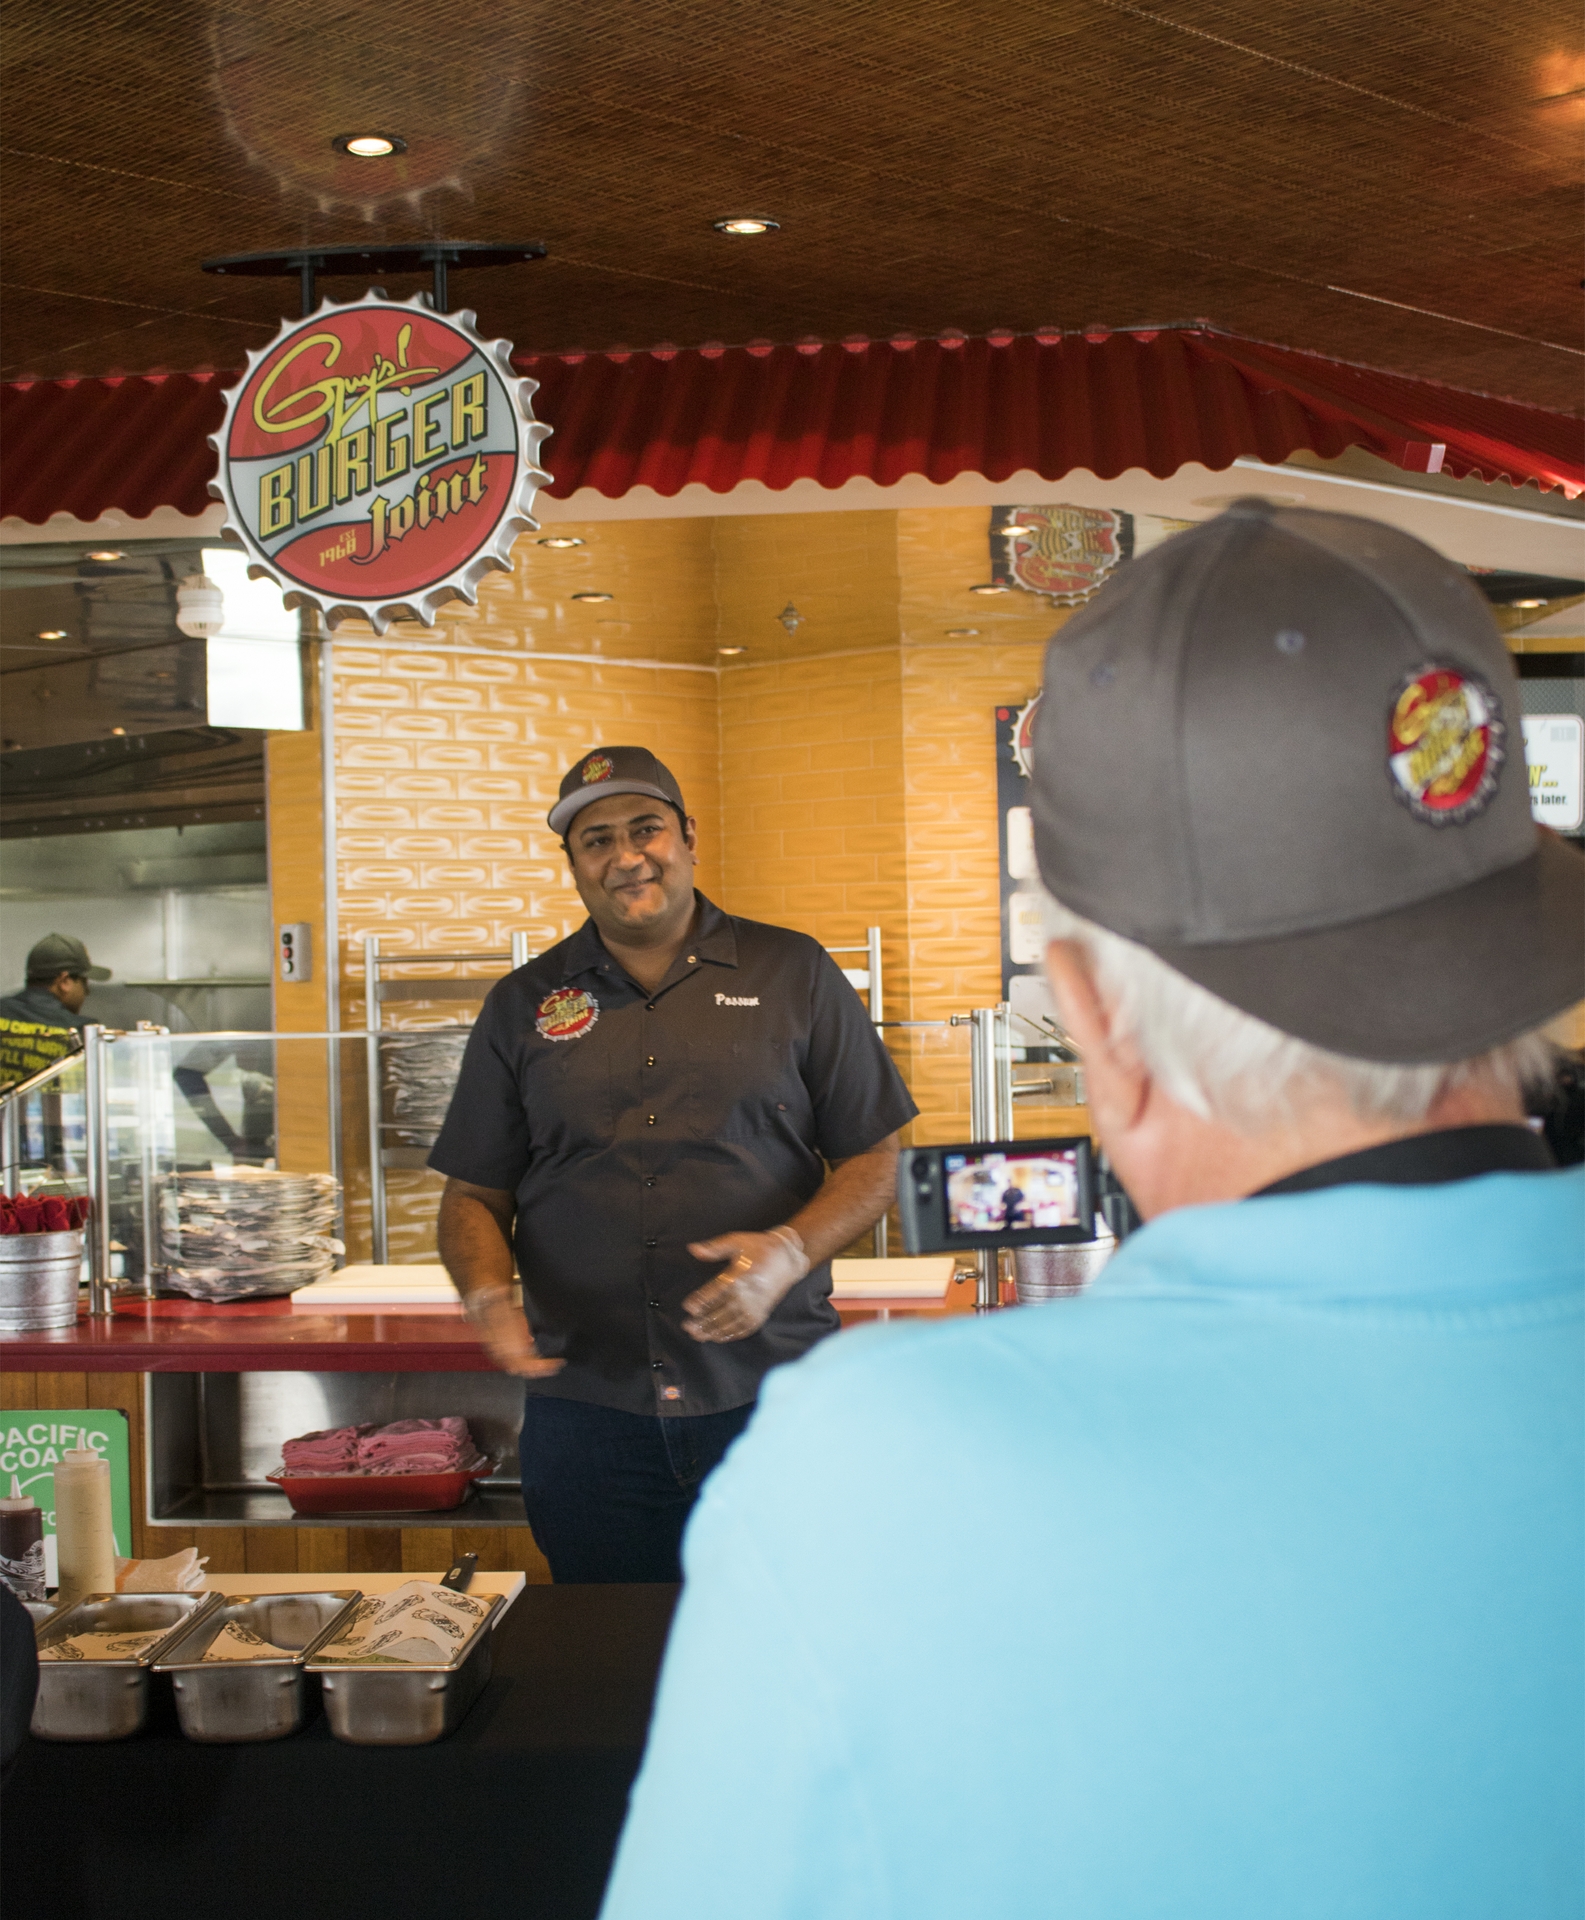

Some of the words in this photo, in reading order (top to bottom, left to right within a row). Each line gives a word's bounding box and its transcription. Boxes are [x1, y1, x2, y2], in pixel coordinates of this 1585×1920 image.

[258, 370, 489, 541] BURGER
[349, 451, 489, 565] Joint
[319, 537, 356, 567] 1968
[0, 1447, 109, 1472] COA
